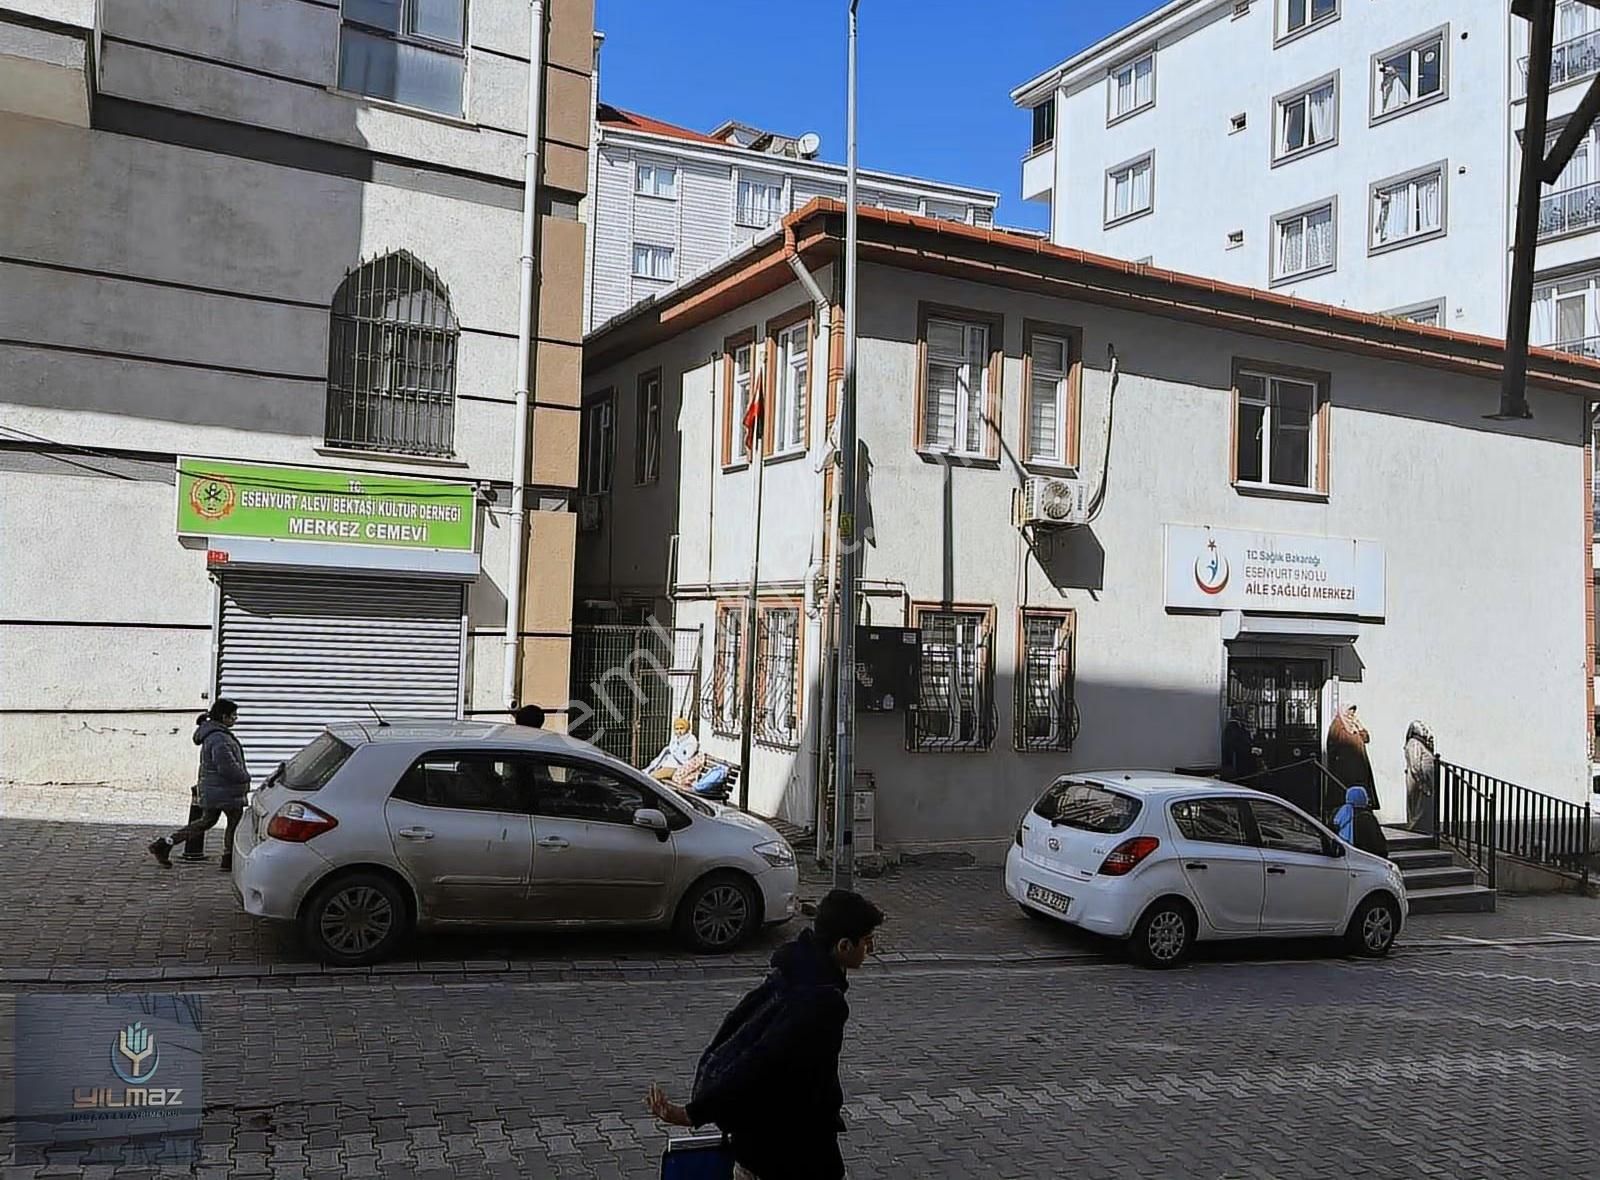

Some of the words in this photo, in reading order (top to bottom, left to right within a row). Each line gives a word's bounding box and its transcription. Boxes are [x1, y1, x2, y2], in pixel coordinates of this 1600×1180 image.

[241, 490, 298, 510] ESENYURT
[289, 517, 361, 537] MERKEZ
[365, 522, 428, 542] CEMEVİ
[1245, 565, 1293, 580] ESENYURT
[1245, 580, 1269, 595] AİLE
[1312, 585, 1355, 600] MERKEZİ
